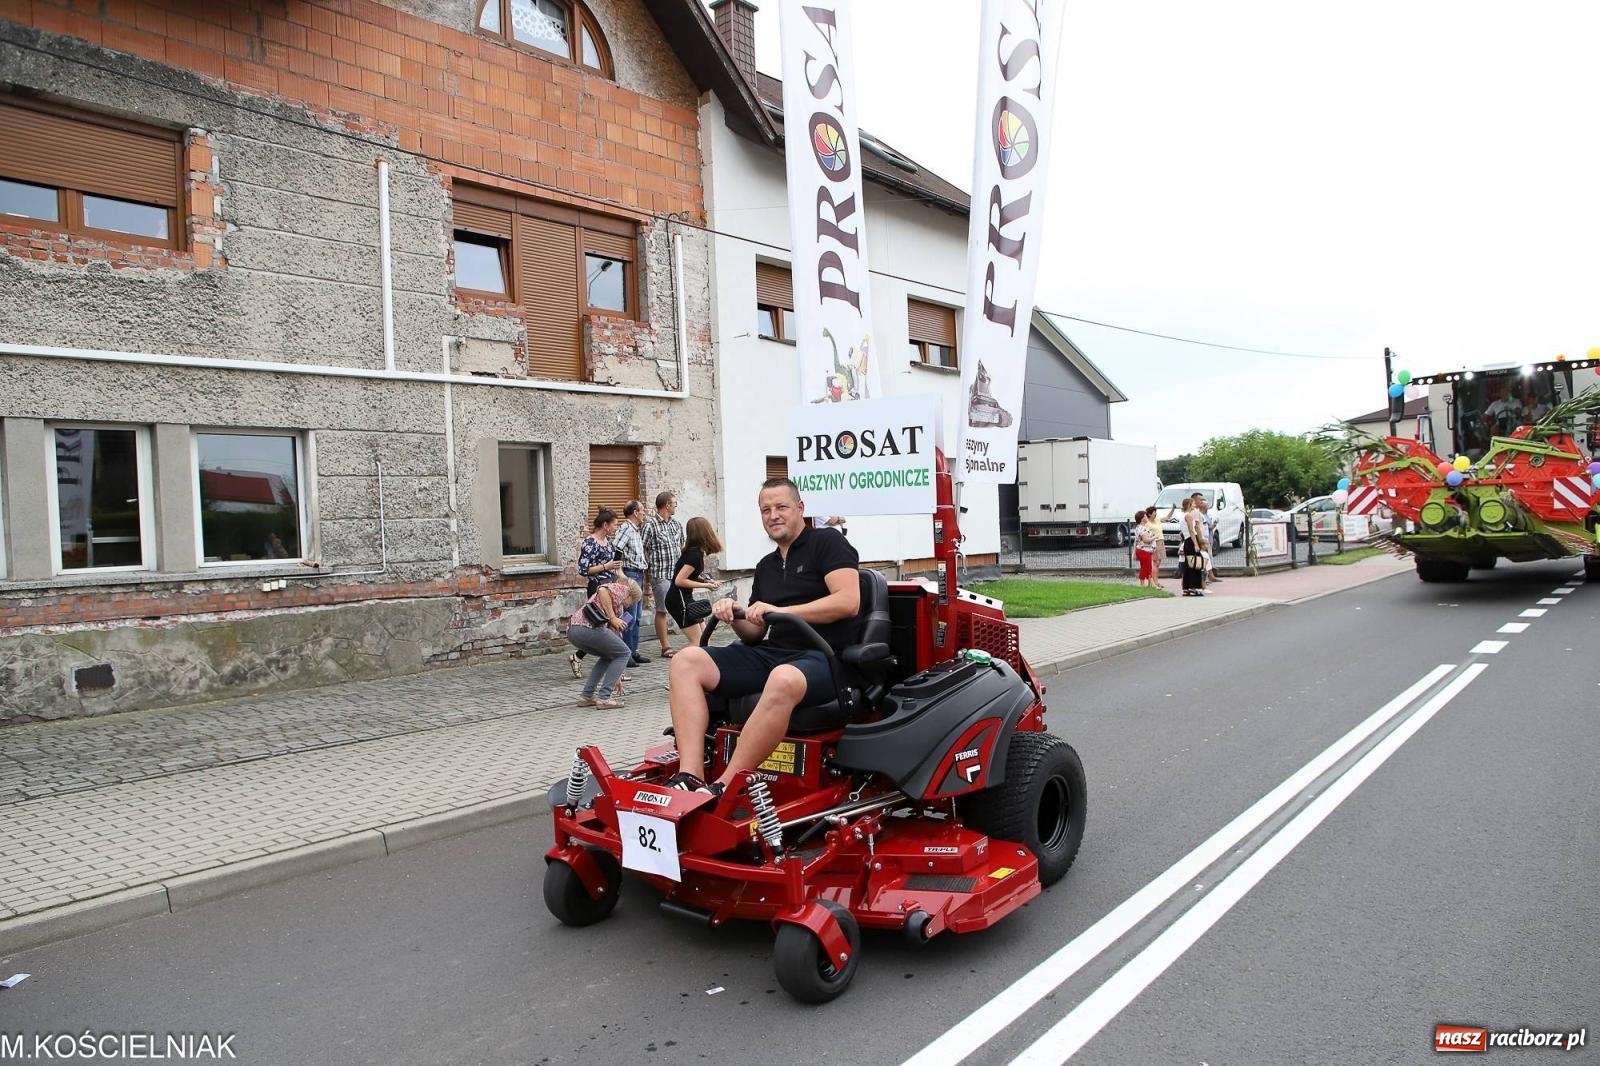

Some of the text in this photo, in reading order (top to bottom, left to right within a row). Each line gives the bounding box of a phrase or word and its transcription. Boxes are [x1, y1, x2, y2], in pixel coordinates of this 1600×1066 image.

[796, 425, 924, 463] PROSAT
[56, 430, 82, 486] PR
[793, 468, 930, 491] MASZYNY OGRODNICZE
[955, 748, 979, 762] FERRIS
[636, 792, 668, 805] PROSAT
[638, 825, 661, 852] 82.
